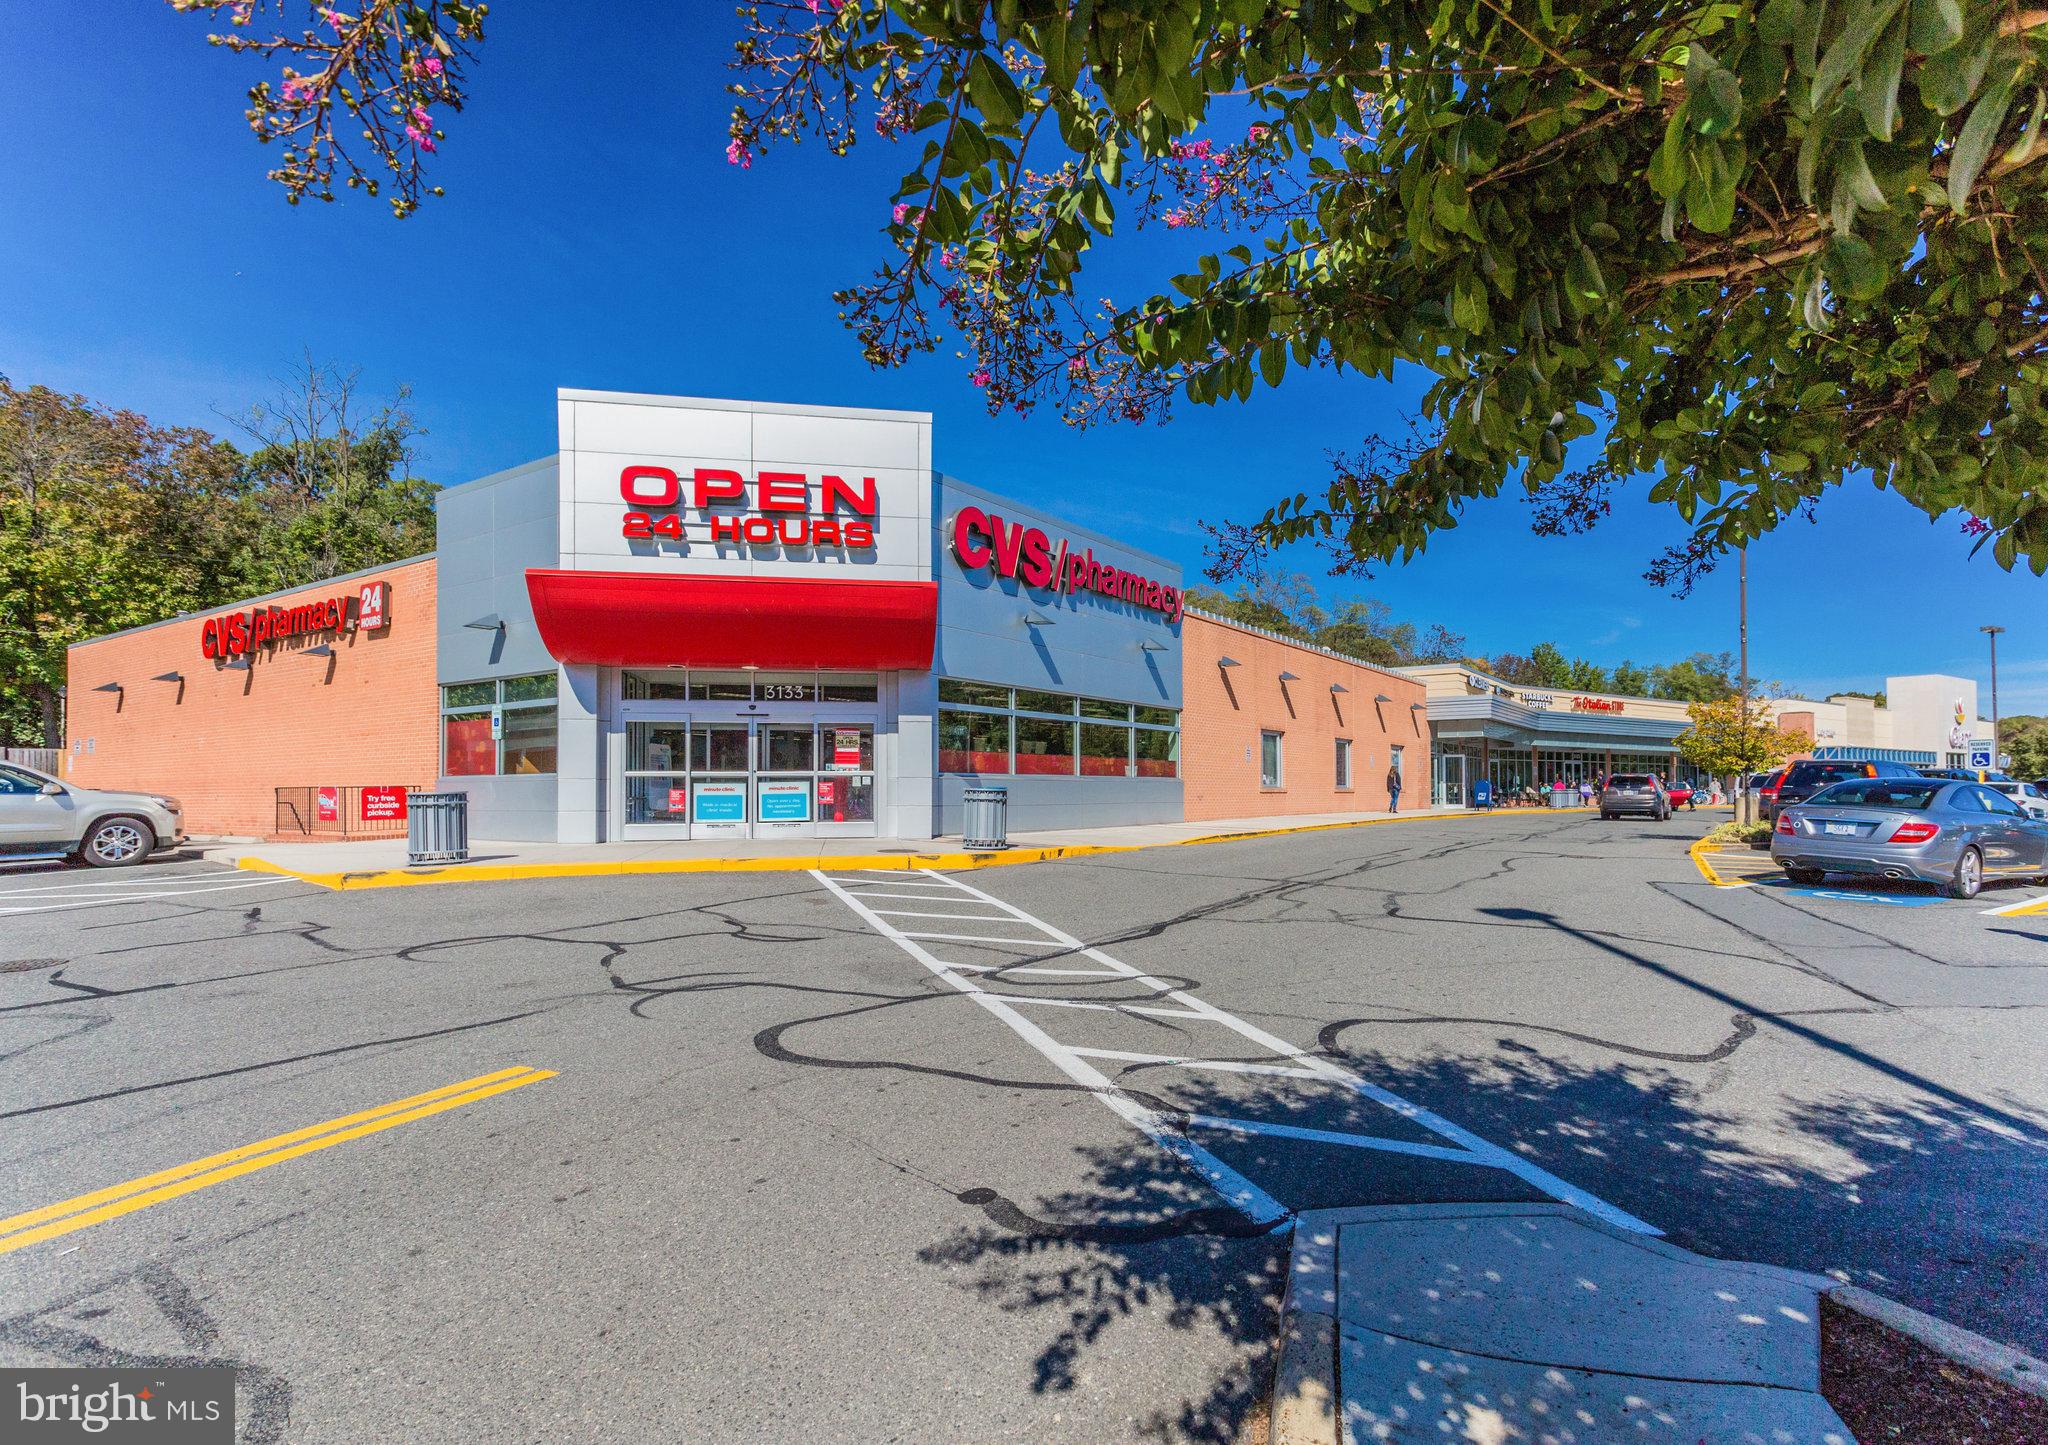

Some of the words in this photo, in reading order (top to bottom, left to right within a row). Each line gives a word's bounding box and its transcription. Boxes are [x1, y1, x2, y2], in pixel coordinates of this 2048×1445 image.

[620, 465, 875, 515] OPEN
[622, 511, 683, 540] 24
[710, 515, 873, 547] HOURS
[361, 587, 381, 615] 24
[361, 615, 381, 628] HOURS
[766, 685, 804, 699] 3133
[367, 795, 379, 803] Try
[367, 809, 394, 817] pickup.
